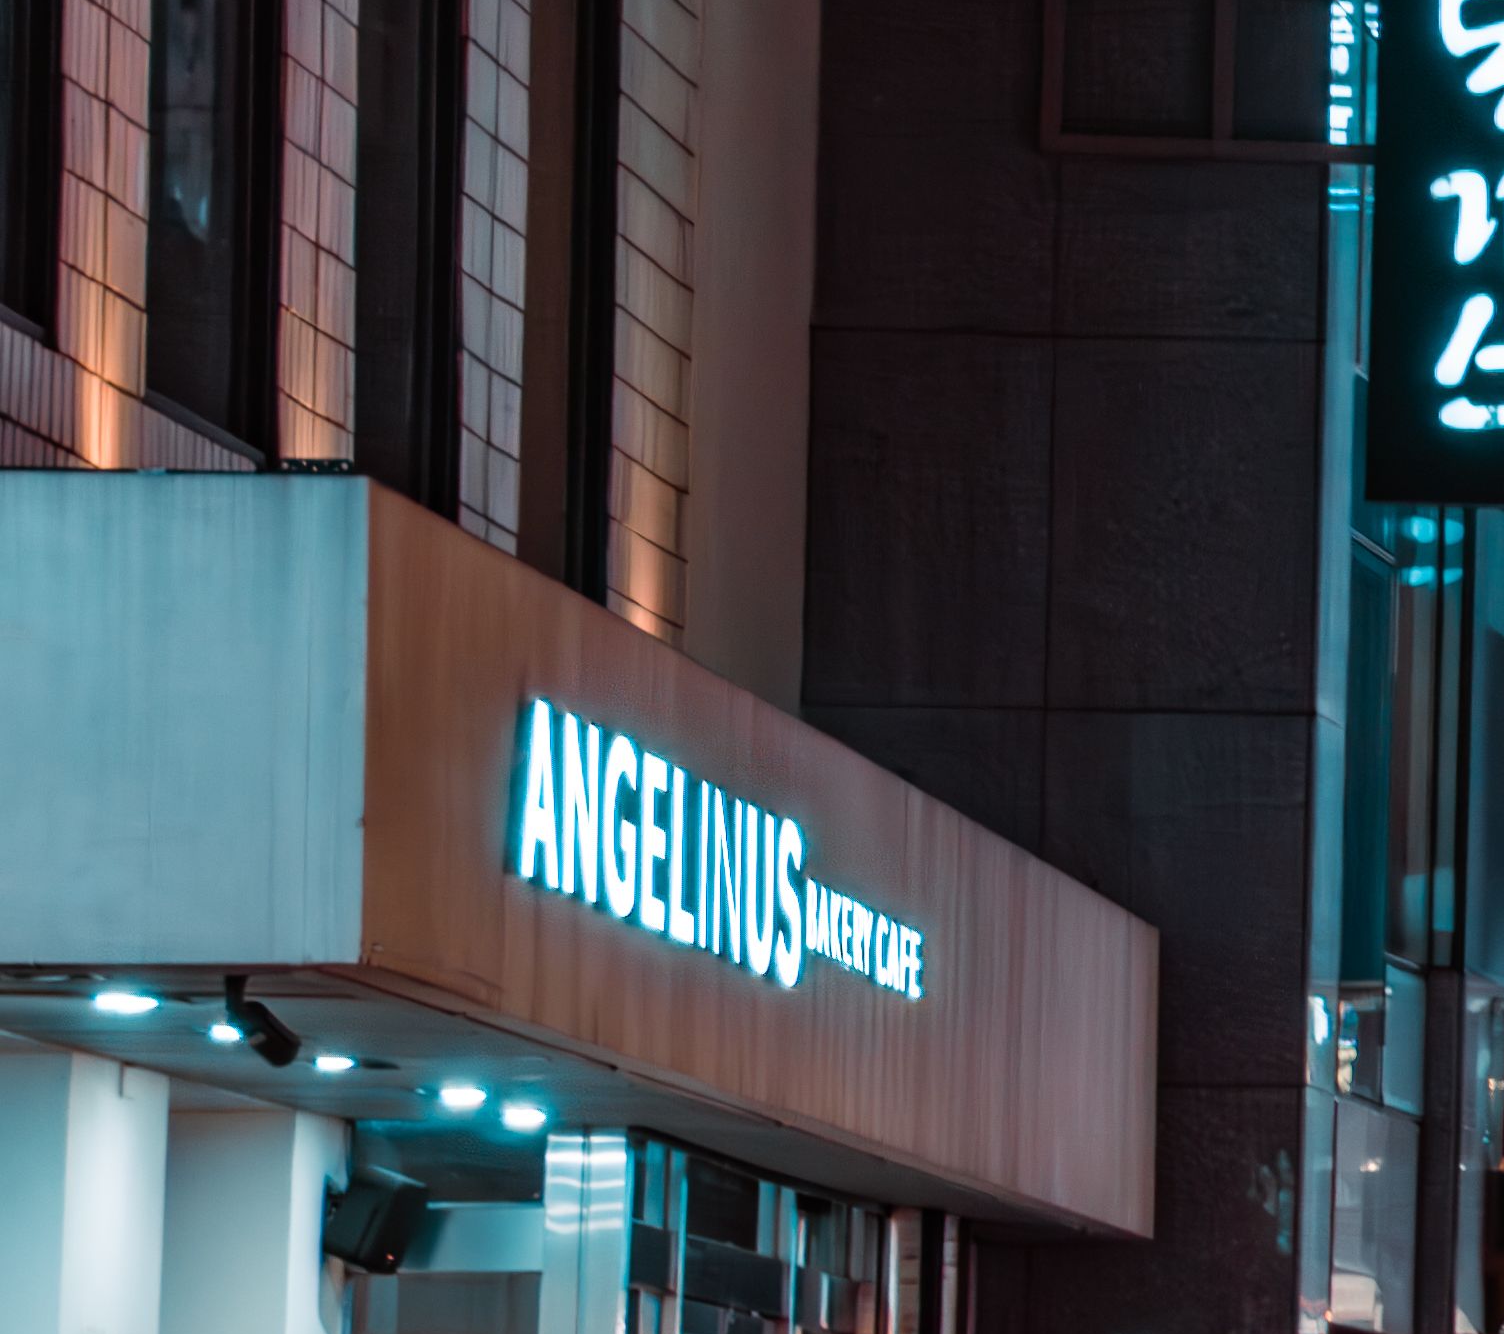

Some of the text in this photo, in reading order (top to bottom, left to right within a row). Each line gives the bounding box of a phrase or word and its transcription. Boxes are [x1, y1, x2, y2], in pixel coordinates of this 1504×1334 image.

[518, 695, 926, 1000] ANGELINUS BAKERY CAFE
